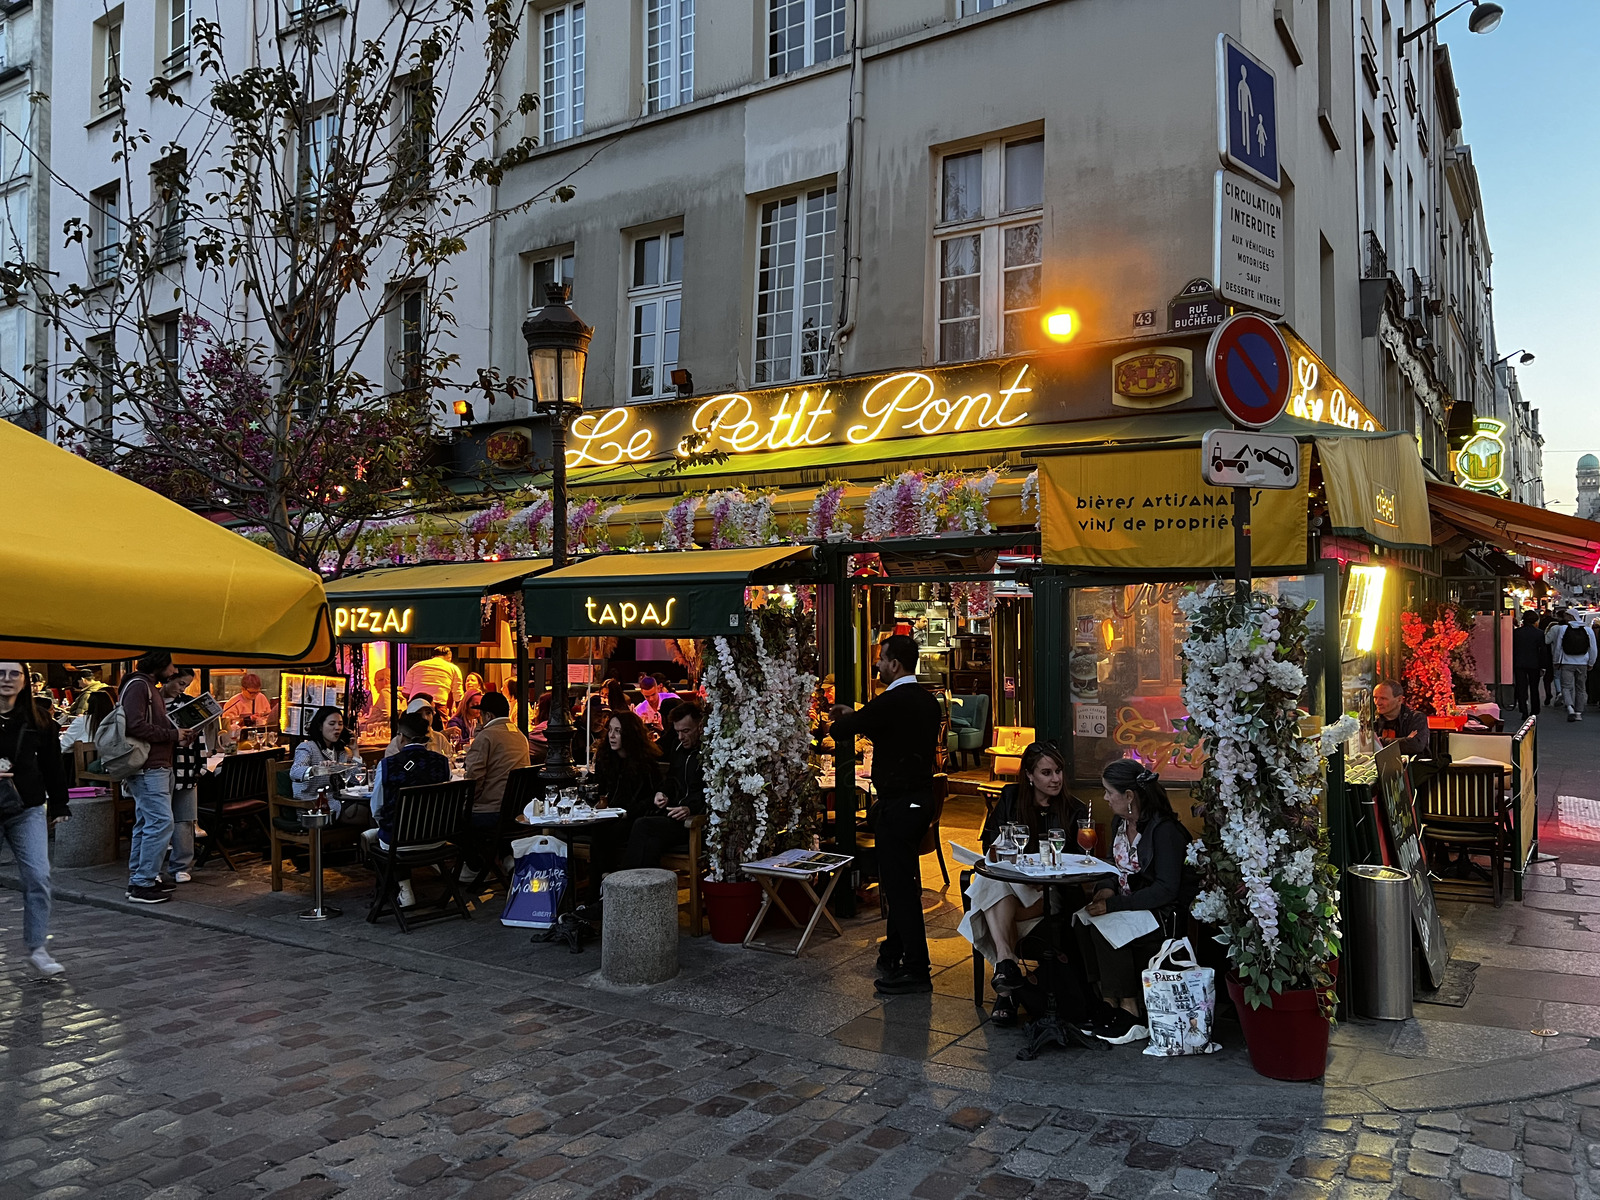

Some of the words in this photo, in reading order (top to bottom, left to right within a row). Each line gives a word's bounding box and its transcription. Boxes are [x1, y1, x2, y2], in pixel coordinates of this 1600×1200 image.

[1225, 182, 1281, 219] CIRCULATION
[1230, 206, 1276, 239] INTERDITE
[1231, 234, 1243, 246] AUX
[1245, 239, 1275, 258] VÉHICULES
[1237, 252, 1270, 272] MOTORISÉS
[1246, 272, 1261, 285] SAUF
[1225, 281, 1255, 298] DESSERTE
[1257, 291, 1281, 307] INTERNE
[1135, 312, 1152, 326] 43
[1188, 304, 1209, 314] RUE
[565, 407, 652, 469] Le
[678, 389, 833, 457] Petit
[847, 363, 1033, 445] Pont
[1123, 517, 1146, 531] de
